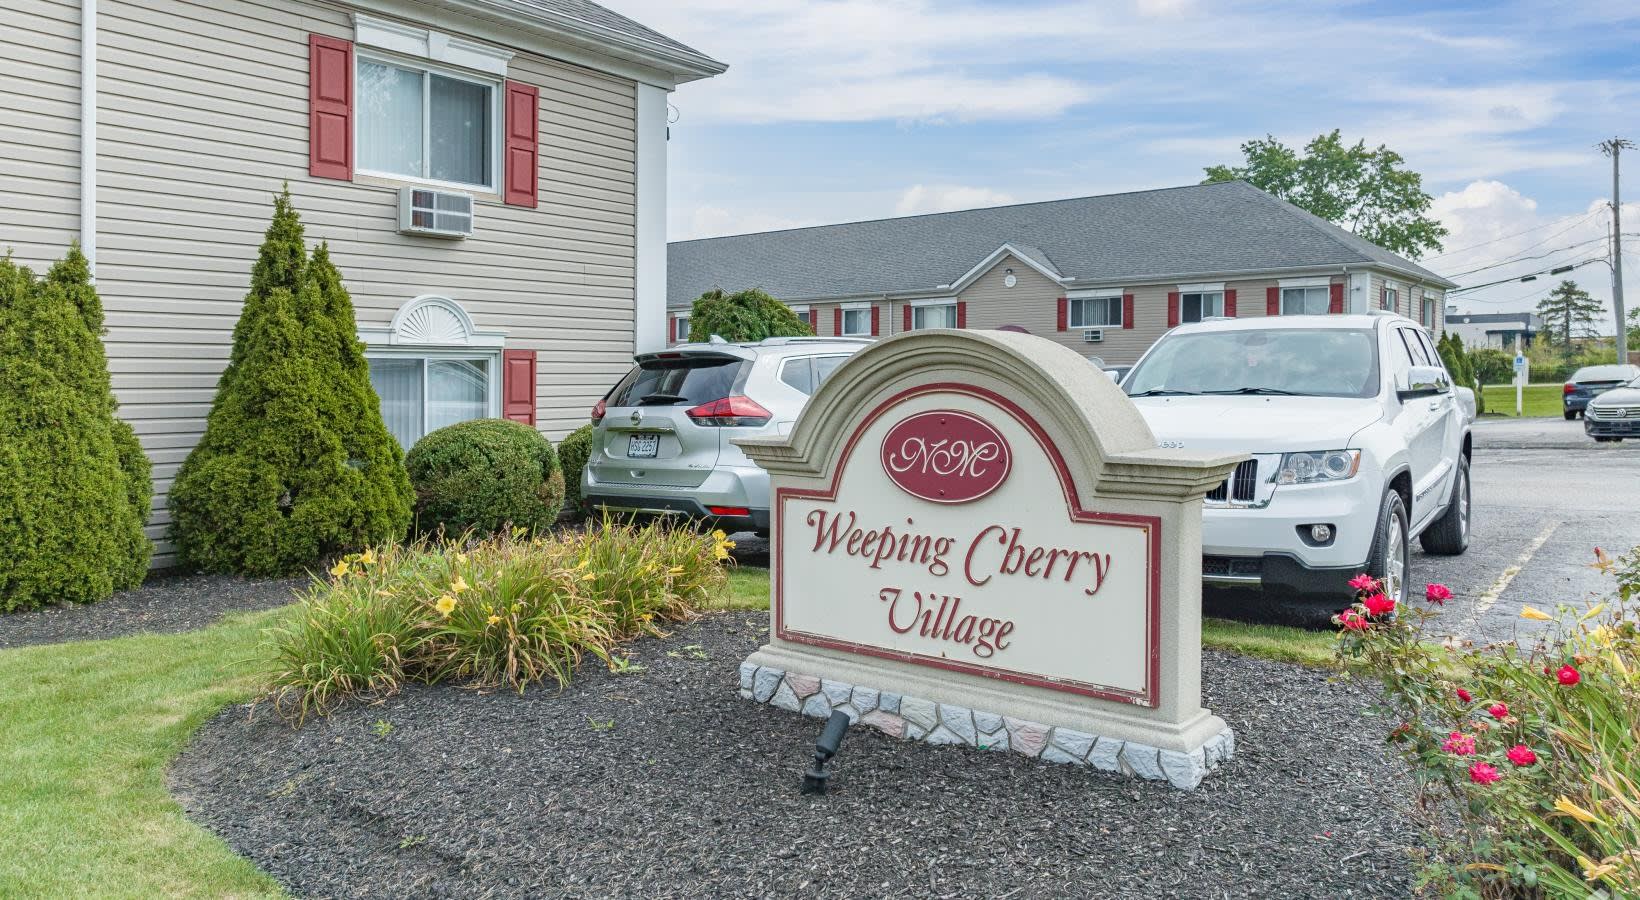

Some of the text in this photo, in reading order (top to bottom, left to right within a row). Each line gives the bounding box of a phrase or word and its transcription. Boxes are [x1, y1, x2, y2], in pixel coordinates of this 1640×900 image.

[806, 508, 1111, 596] Weeping Cherry
[879, 587, 1015, 658] Village
